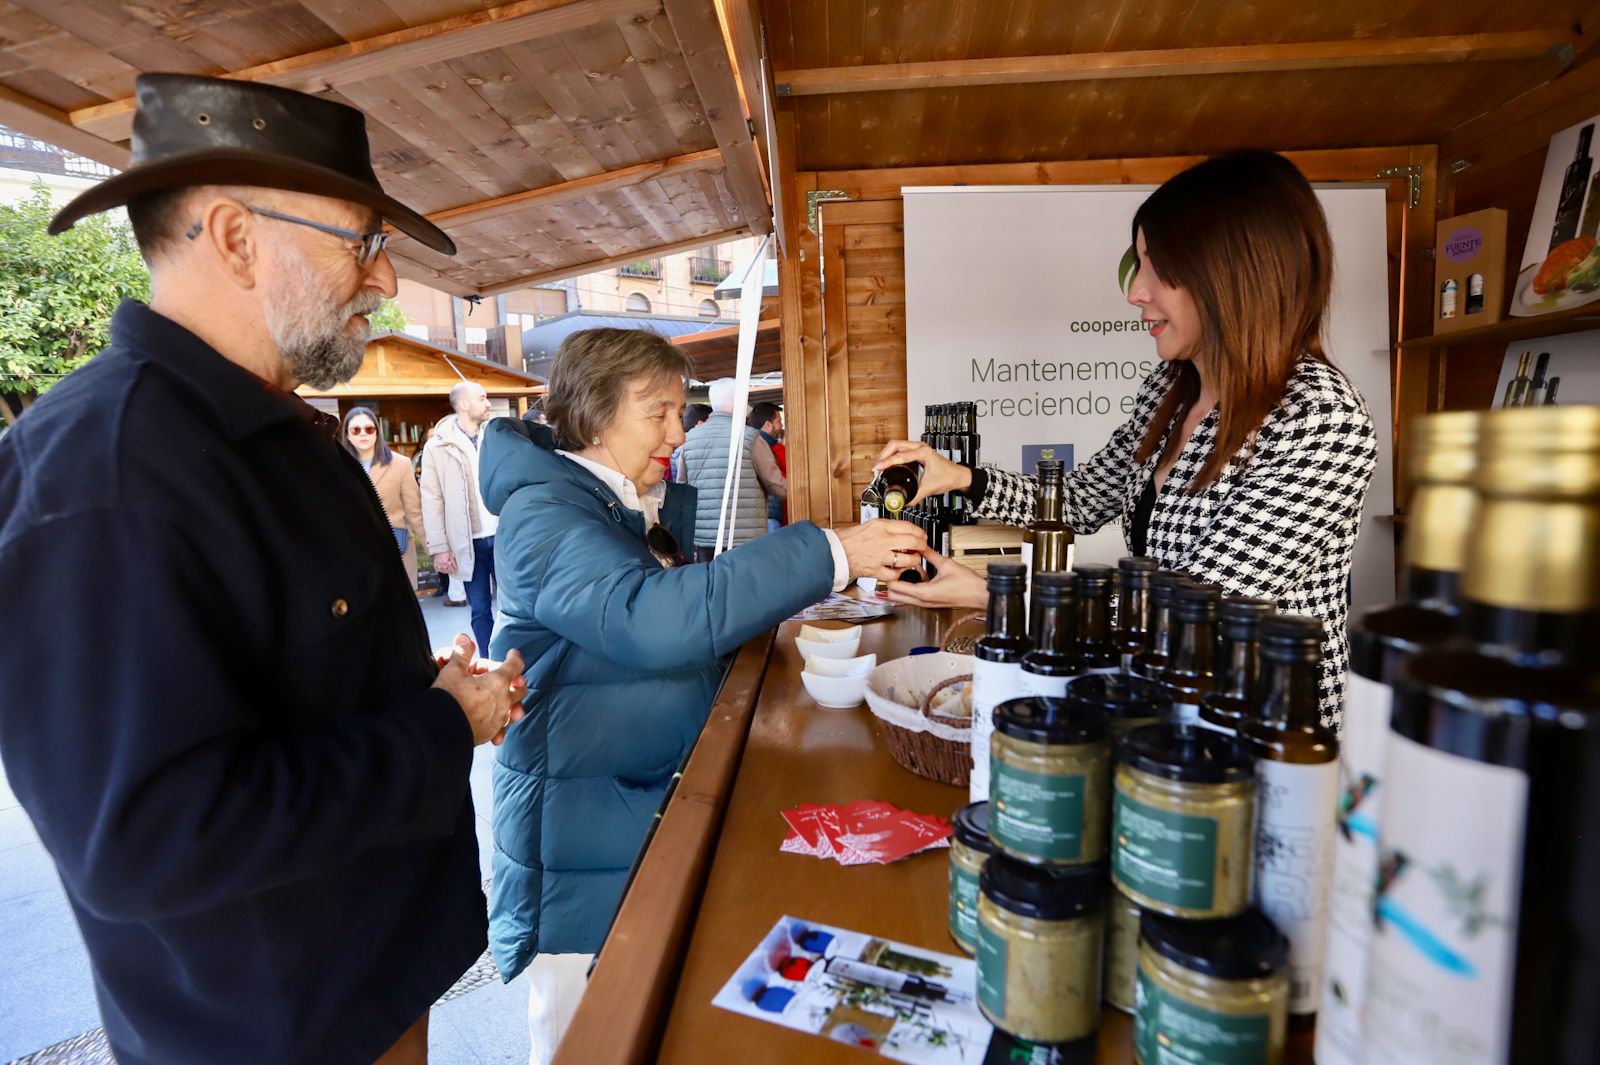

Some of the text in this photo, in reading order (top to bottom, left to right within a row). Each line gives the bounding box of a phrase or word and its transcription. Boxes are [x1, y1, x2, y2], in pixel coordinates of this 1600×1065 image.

[1445, 239, 1482, 255] FUENTE
[971, 358, 1152, 383] Mantenemos
[973, 391, 1111, 418] creciendo
